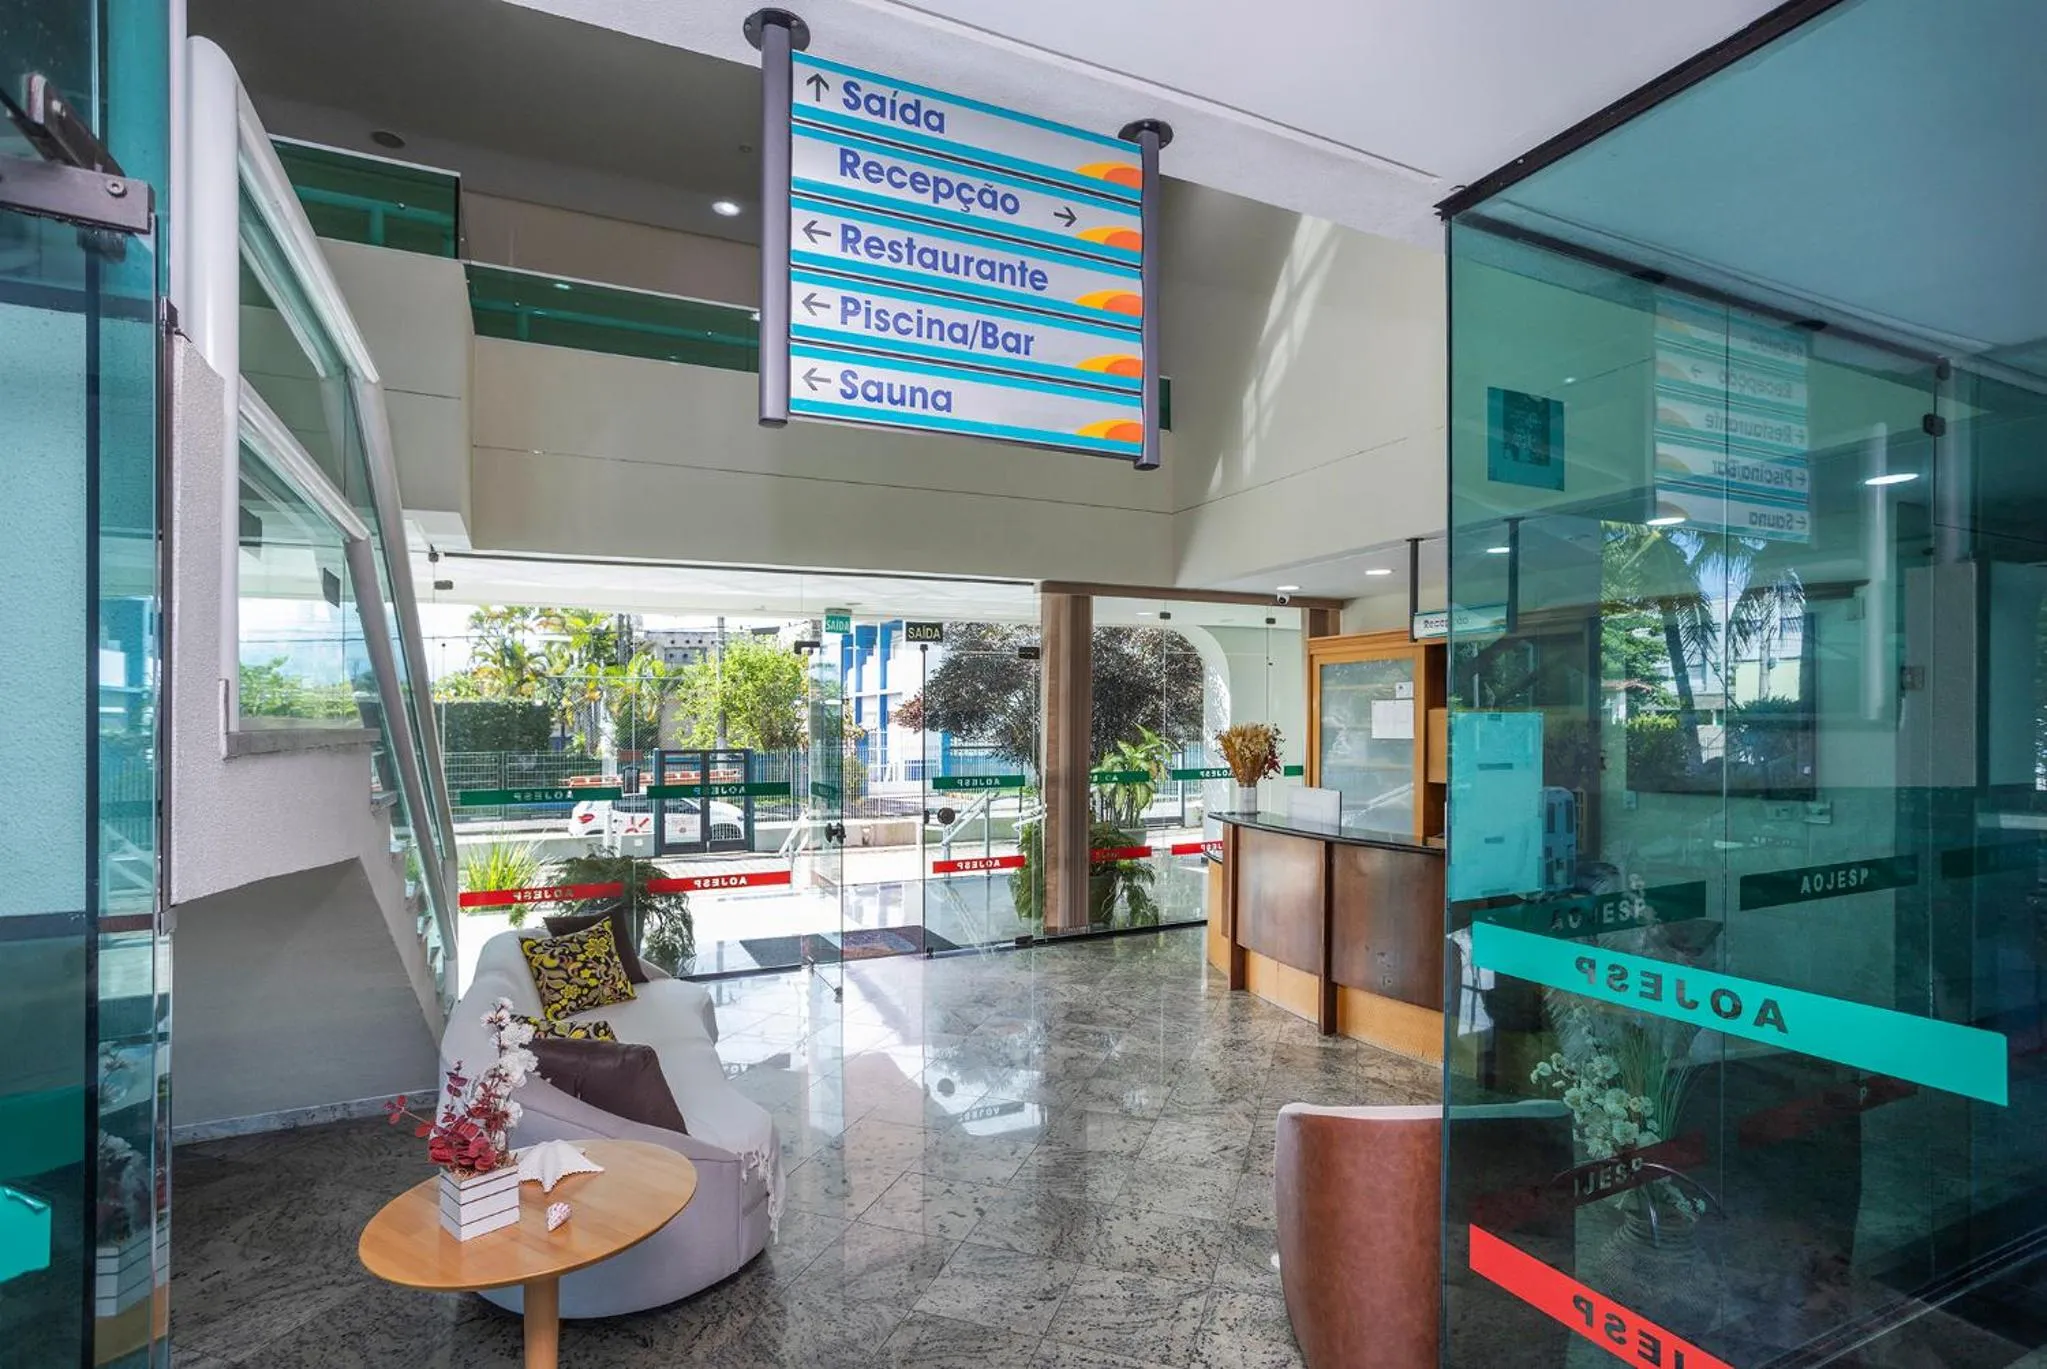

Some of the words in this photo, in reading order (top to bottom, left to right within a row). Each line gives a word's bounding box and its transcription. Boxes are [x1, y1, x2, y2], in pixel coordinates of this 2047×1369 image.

[842, 80, 946, 134] Saída
[839, 147, 1020, 215] Recepção
[840, 224, 1049, 291] Restaurante
[840, 295, 1034, 356] Piscina/Bar
[840, 369, 953, 413] Sauna
[908, 625, 940, 639] SAÍDA
[1800, 868, 1869, 894] AOJESP
